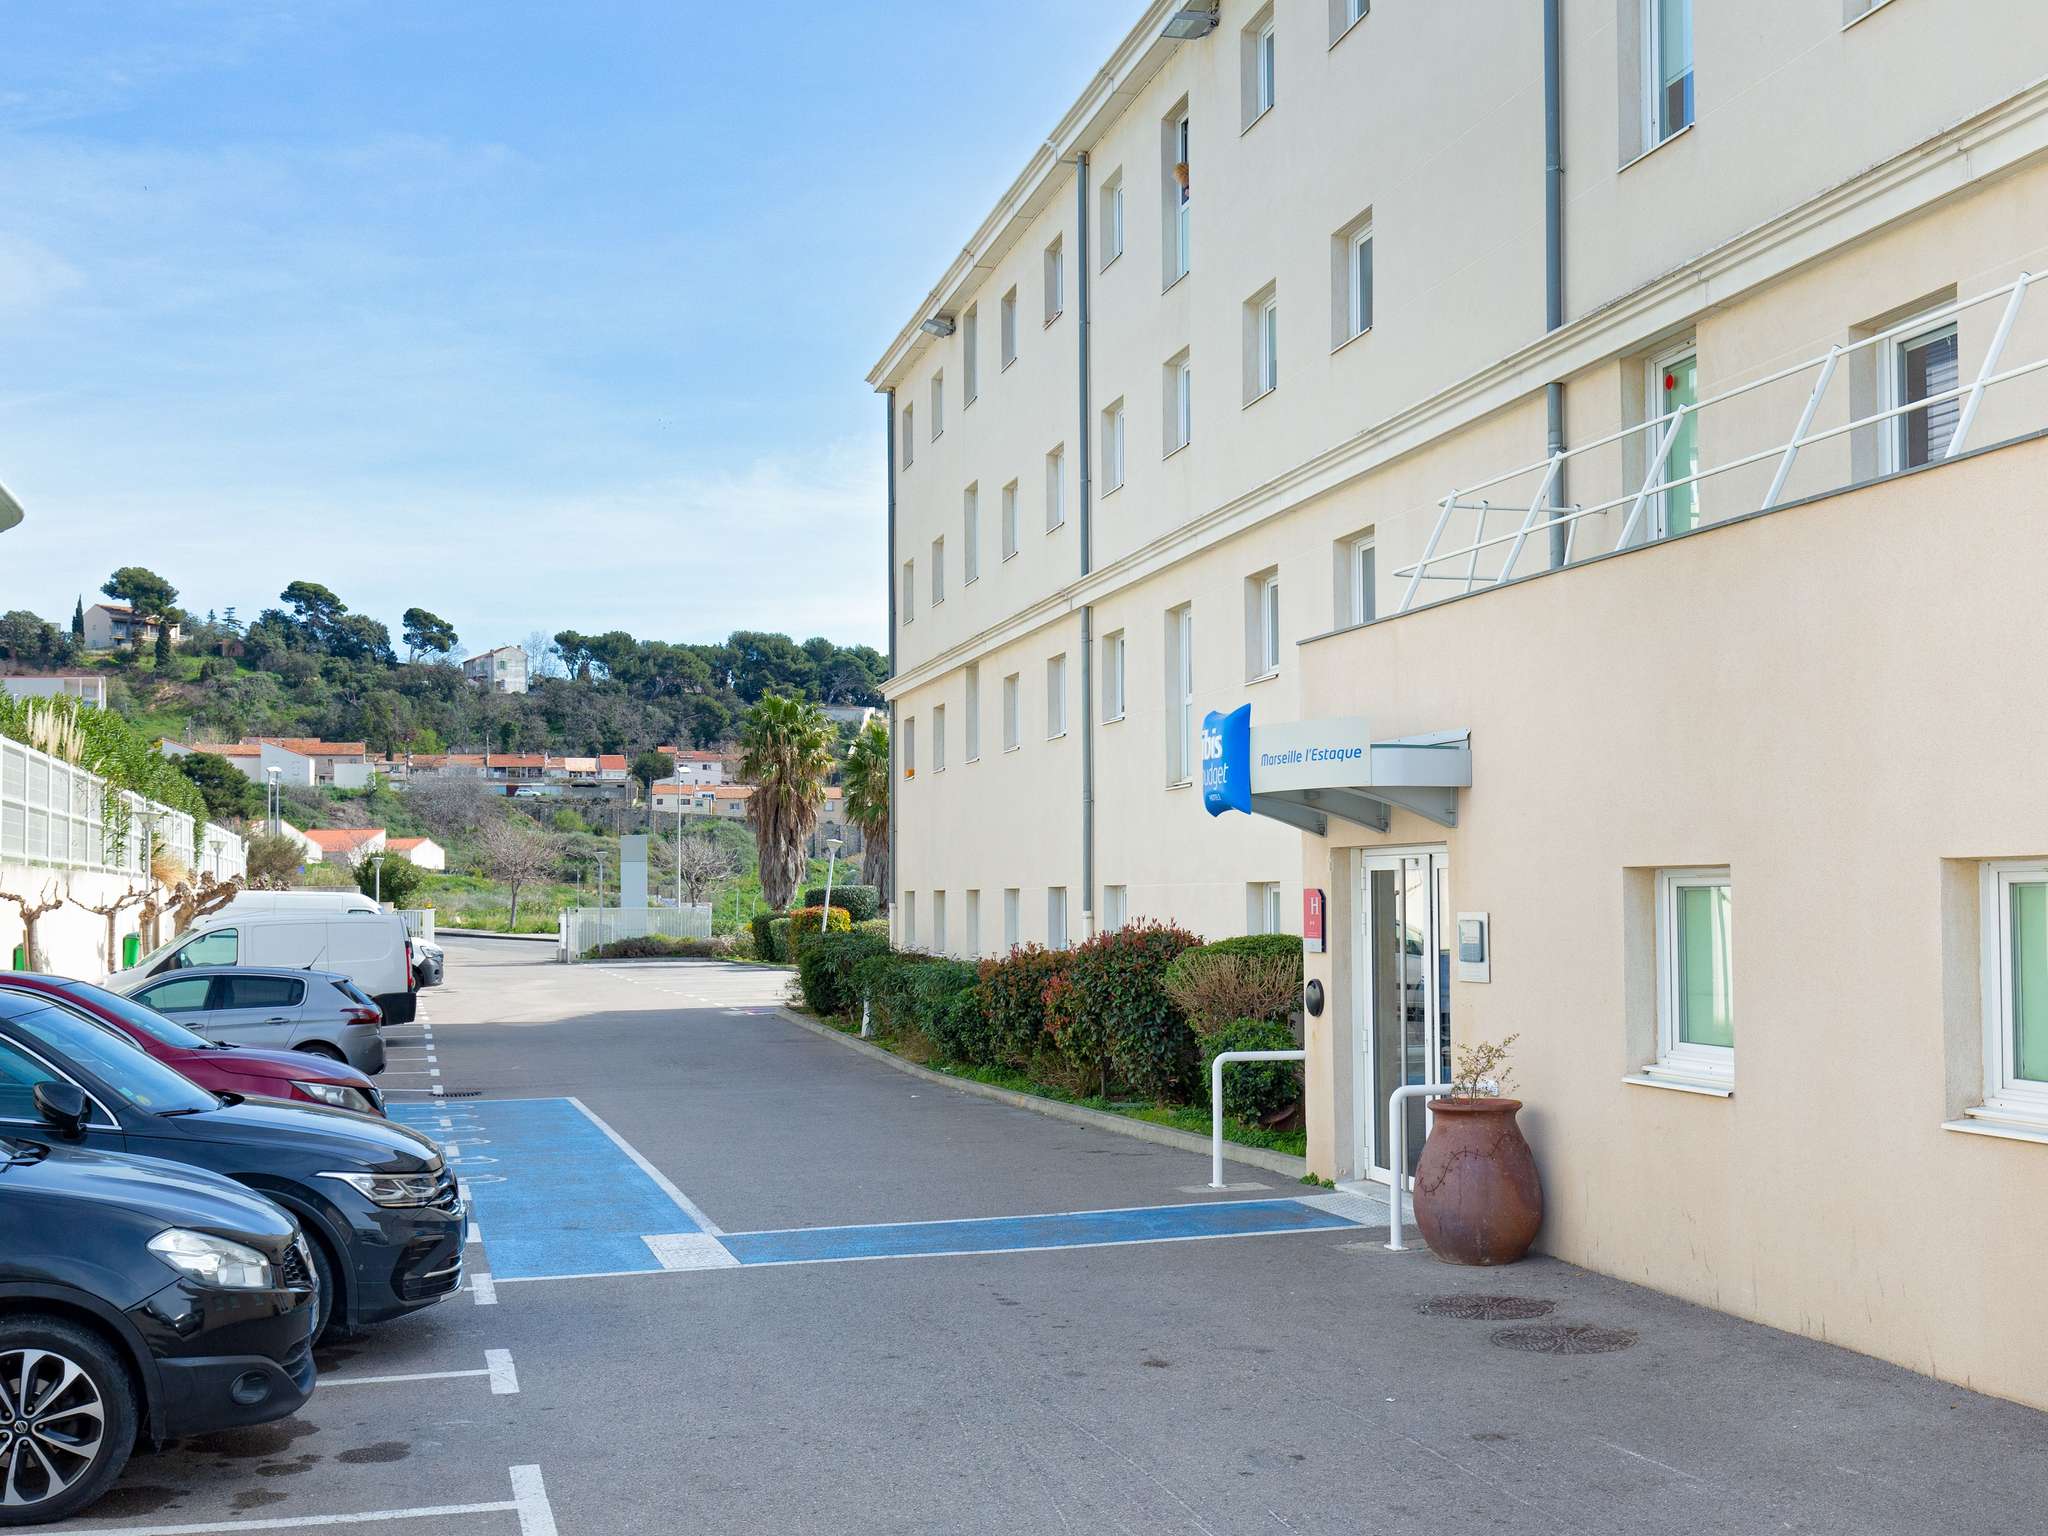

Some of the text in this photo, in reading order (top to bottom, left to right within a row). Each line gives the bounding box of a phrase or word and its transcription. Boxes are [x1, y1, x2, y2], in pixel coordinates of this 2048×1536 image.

[1261, 747, 1362, 766] Marseille l'Estaque
[1202, 762, 1229, 791] udget
[1310, 896, 1319, 915] H
